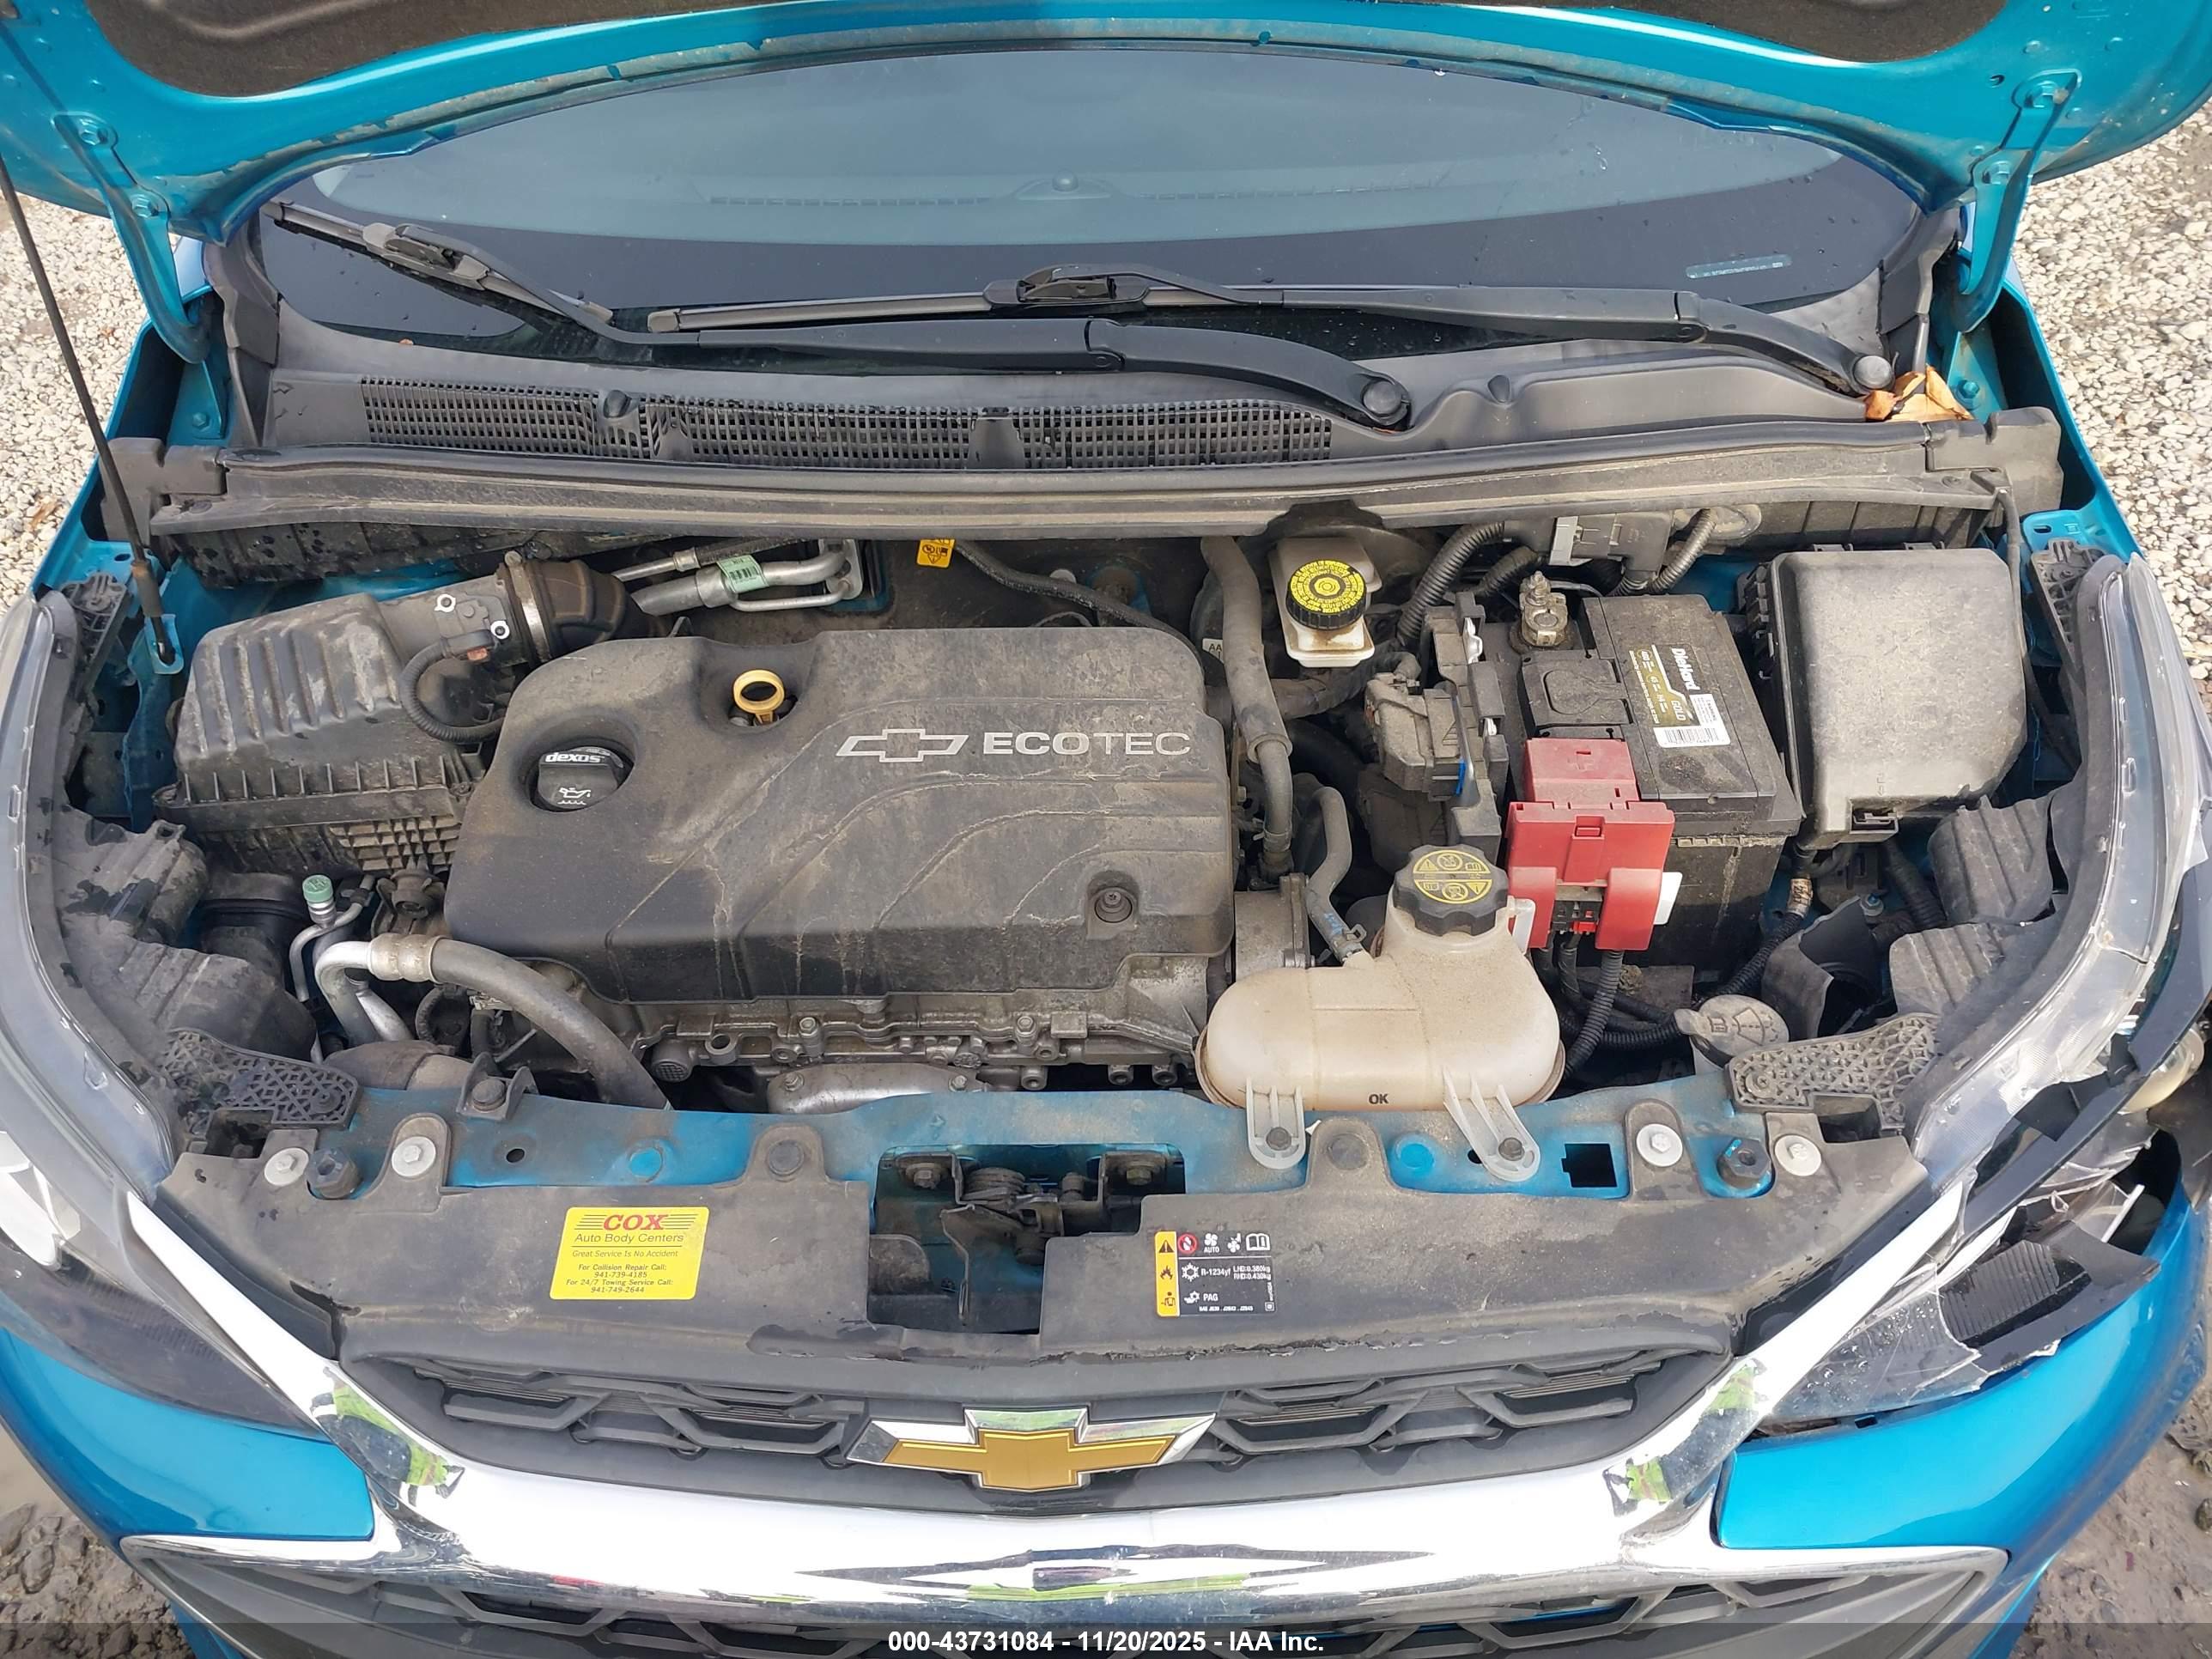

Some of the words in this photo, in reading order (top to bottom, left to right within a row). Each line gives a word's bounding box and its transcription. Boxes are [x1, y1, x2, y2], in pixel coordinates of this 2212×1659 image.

[1671, 647, 1701, 690] DieHard
[1671, 700, 1686, 721] GOLD
[983, 732, 1191, 756] ECOTEC
[544, 752, 605, 763] dexos
[1368, 1093, 1389, 1104] OK
[604, 1214, 669, 1231] COX
[574, 1233, 601, 1243] Auto
[605, 1233, 635, 1244] Body
[638, 1233, 684, 1243] Centers
[1200, 1267, 1231, 1277] R-1234yf
[1203, 1292, 1218, 1302] PAG
